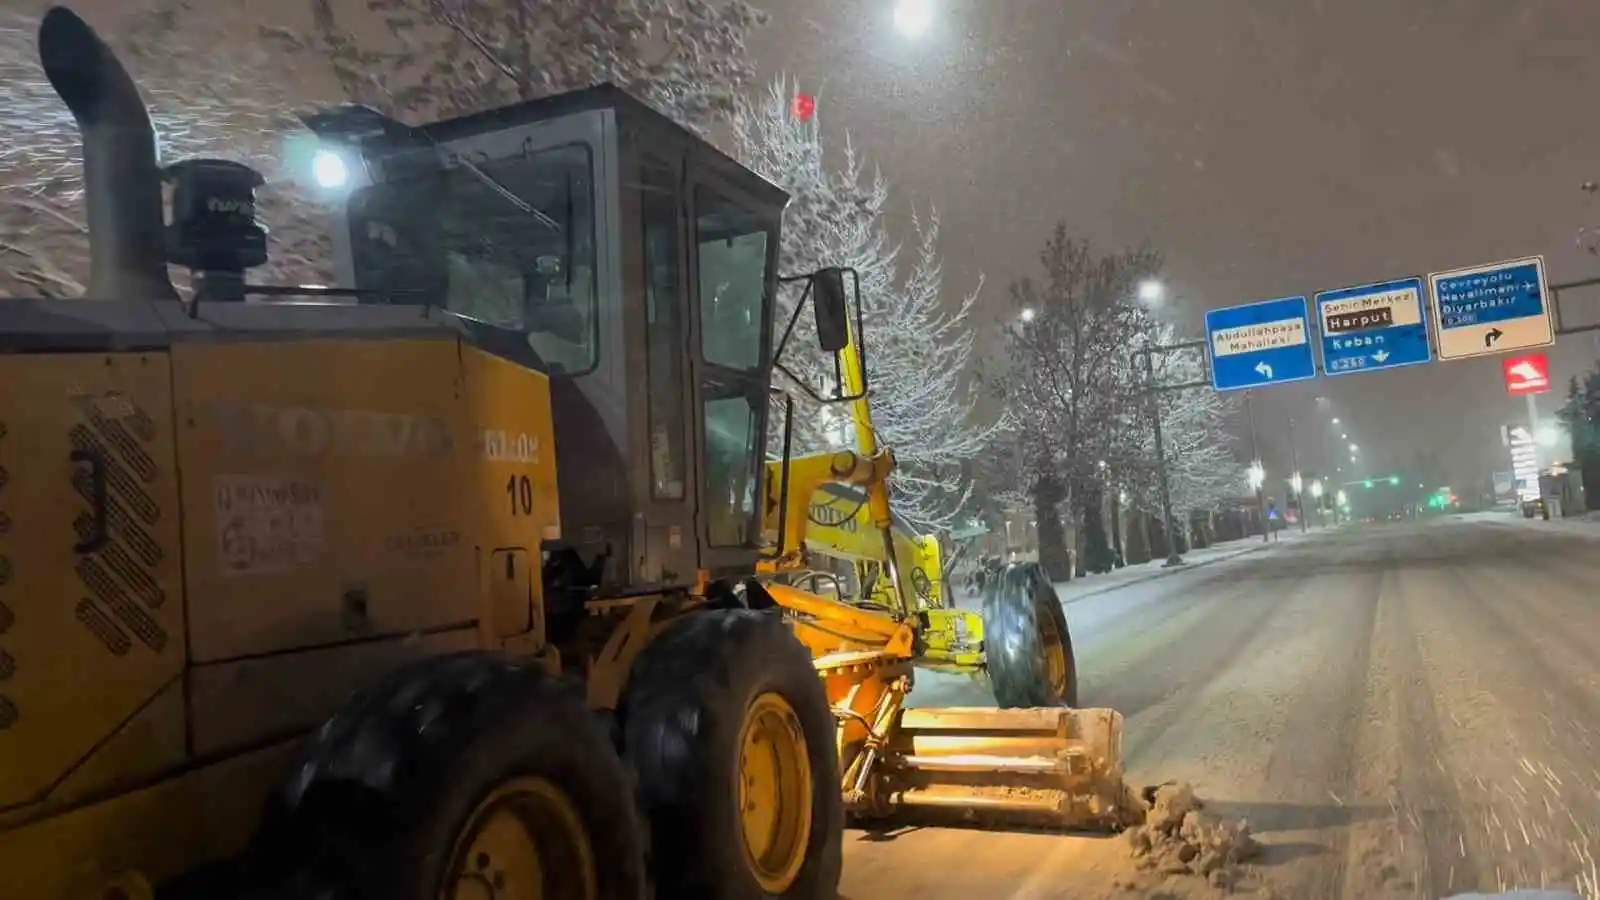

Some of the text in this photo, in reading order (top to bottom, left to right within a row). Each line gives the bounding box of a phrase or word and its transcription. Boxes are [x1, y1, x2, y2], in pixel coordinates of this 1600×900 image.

[1330, 312, 1389, 329] Harput
[1333, 335, 1384, 350] Keban
[506, 473, 532, 516] 10
